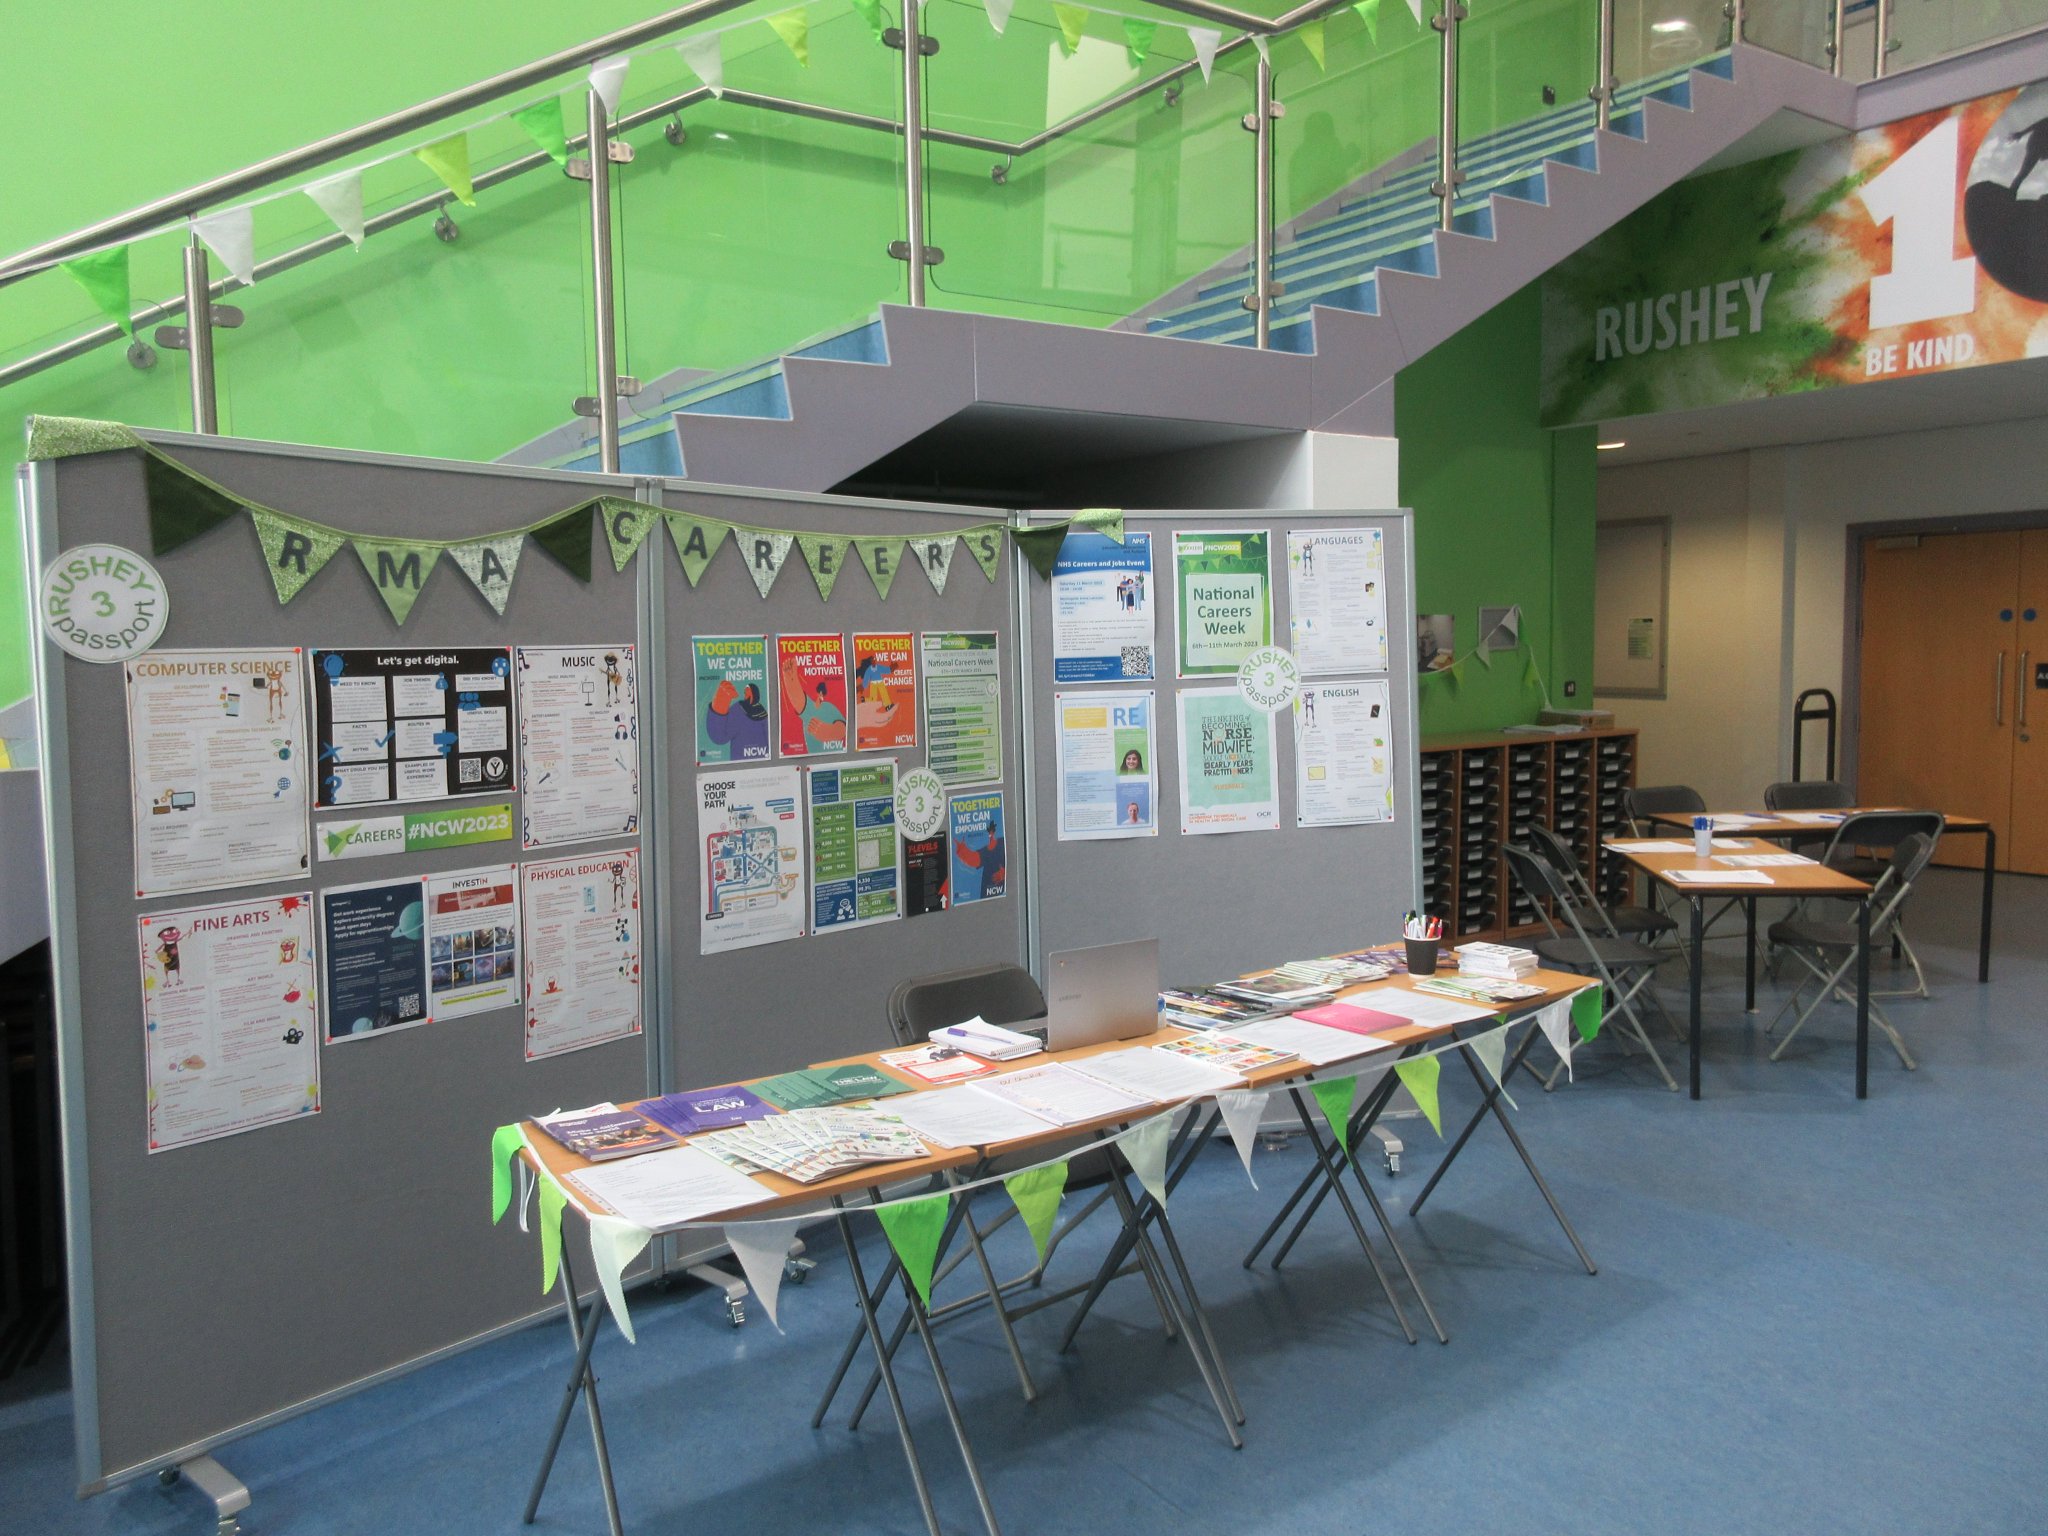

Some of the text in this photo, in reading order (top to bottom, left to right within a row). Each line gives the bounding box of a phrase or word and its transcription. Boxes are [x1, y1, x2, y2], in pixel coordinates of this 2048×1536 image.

[1595, 272, 1772, 361] RUSHEY
[1866, 333, 1973, 376] BE KIND
[612, 512, 996, 576] CAREERS
[1112, 560, 1126, 568] Jobs
[49, 556, 157, 617] RUSHEY
[1193, 585, 1255, 601] National
[91, 591, 117, 618] 3
[1197, 605, 1252, 619] Careers
[52, 598, 156, 650] passport
[1204, 621, 1246, 635] Week
[697, 641, 763, 656] TOGETHER
[780, 640, 841, 653] TOGETHER
[856, 639, 911, 651] TOGETHER
[377, 655, 460, 667] Let's get digital.
[562, 656, 596, 667] MUSIC
[707, 657, 752, 670] WE CAN
[795, 655, 837, 667] WE CAN
[875, 652, 908, 662] WE CAN
[928, 657, 994, 667] National Careers Week
[136, 660, 292, 677] COMPUTER SCIENCE
[804, 666, 844, 676] MOTIVATE
[1243, 652, 1297, 683] RUSHEY
[725, 669, 763, 682] INSPIRE
[883, 677, 913, 686] CHANGE
[1264, 672, 1275, 687] 3
[1241, 677, 1293, 707] passport
[1322, 688, 1360, 698] ENGLISH
[1113, 707, 1140, 726] RE
[1202, 715, 1244, 723] THINKING
[1202, 722, 1246, 730] BECOMING
[823, 740, 844, 750] NCW
[895, 734, 914, 744] NCW
[743, 746, 767, 757] NCW
[1203, 739, 1255, 755] MIDWIFE,
[1211, 760, 1231, 769] EARLY
[1231, 760, 1254, 768] YEARS
[703, 781, 736, 791] CHOOSE
[897, 774, 943, 808] RUSHEY
[704, 791, 727, 800] YOUR
[704, 800, 725, 809] PATH
[915, 796, 925, 813] 3
[952, 797, 1001, 812] TOGETHER
[896, 804, 941, 834] passport
[957, 811, 991, 824] WE CAN
[346, 828, 403, 845] CAREERS
[408, 814, 509, 840] #NCW2023
[955, 822, 987, 834] EMPOWER
[531, 860, 630, 882] PHYSICAL EDUCATION
[452, 877, 489, 889] INVESTIN
[986, 886, 1004, 896] NCW
[193, 910, 270, 933] FINE ARTS
[694, 1100, 745, 1113] LAW
